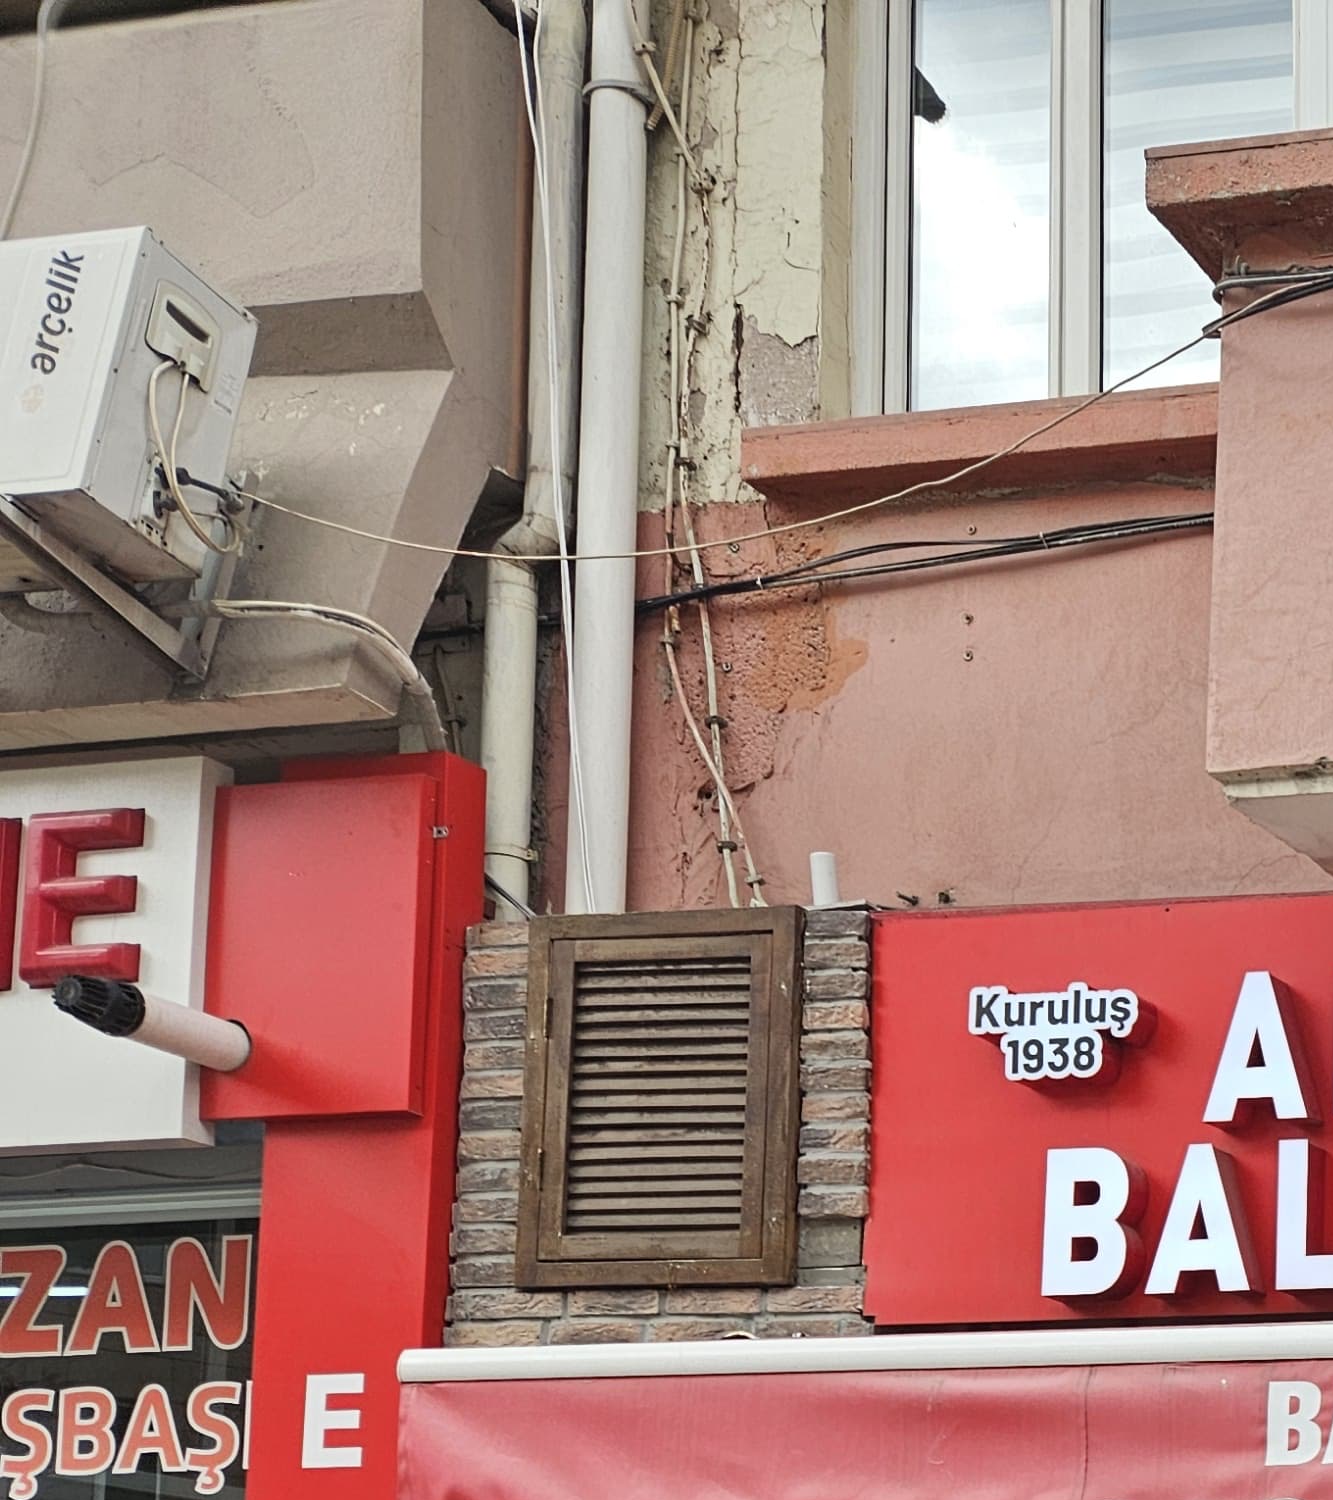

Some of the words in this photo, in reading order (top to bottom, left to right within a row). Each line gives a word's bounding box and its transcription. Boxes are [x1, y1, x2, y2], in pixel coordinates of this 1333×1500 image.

[31, 250, 85, 375] arçelik
[0, 808, 145, 991] E
[973, 987, 1133, 1034] Kuruluş
[1004, 1034, 1098, 1076] 1938
[0, 1380, 254, 1500] ŞBAŞ
